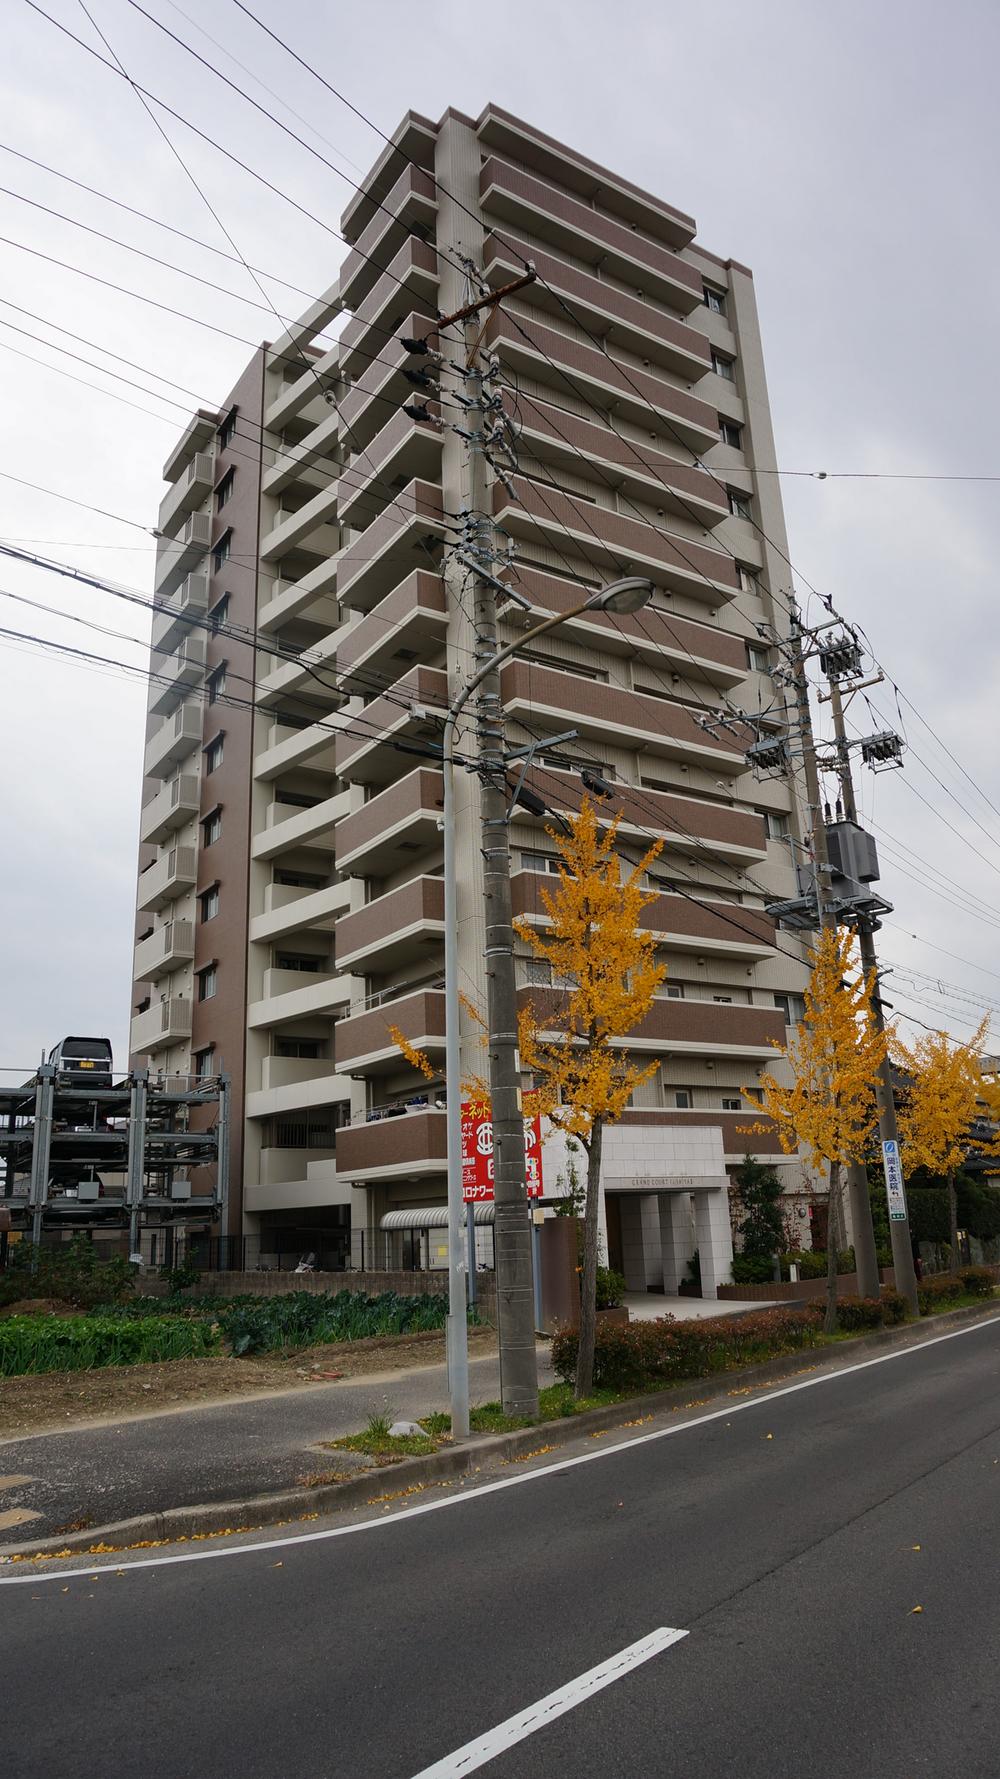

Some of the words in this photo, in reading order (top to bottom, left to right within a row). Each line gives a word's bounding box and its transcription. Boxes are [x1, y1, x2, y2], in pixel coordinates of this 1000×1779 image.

[887, 1157, 898, 1190] 岡本医院
[462, 1185, 494, 1198] ロナワー
